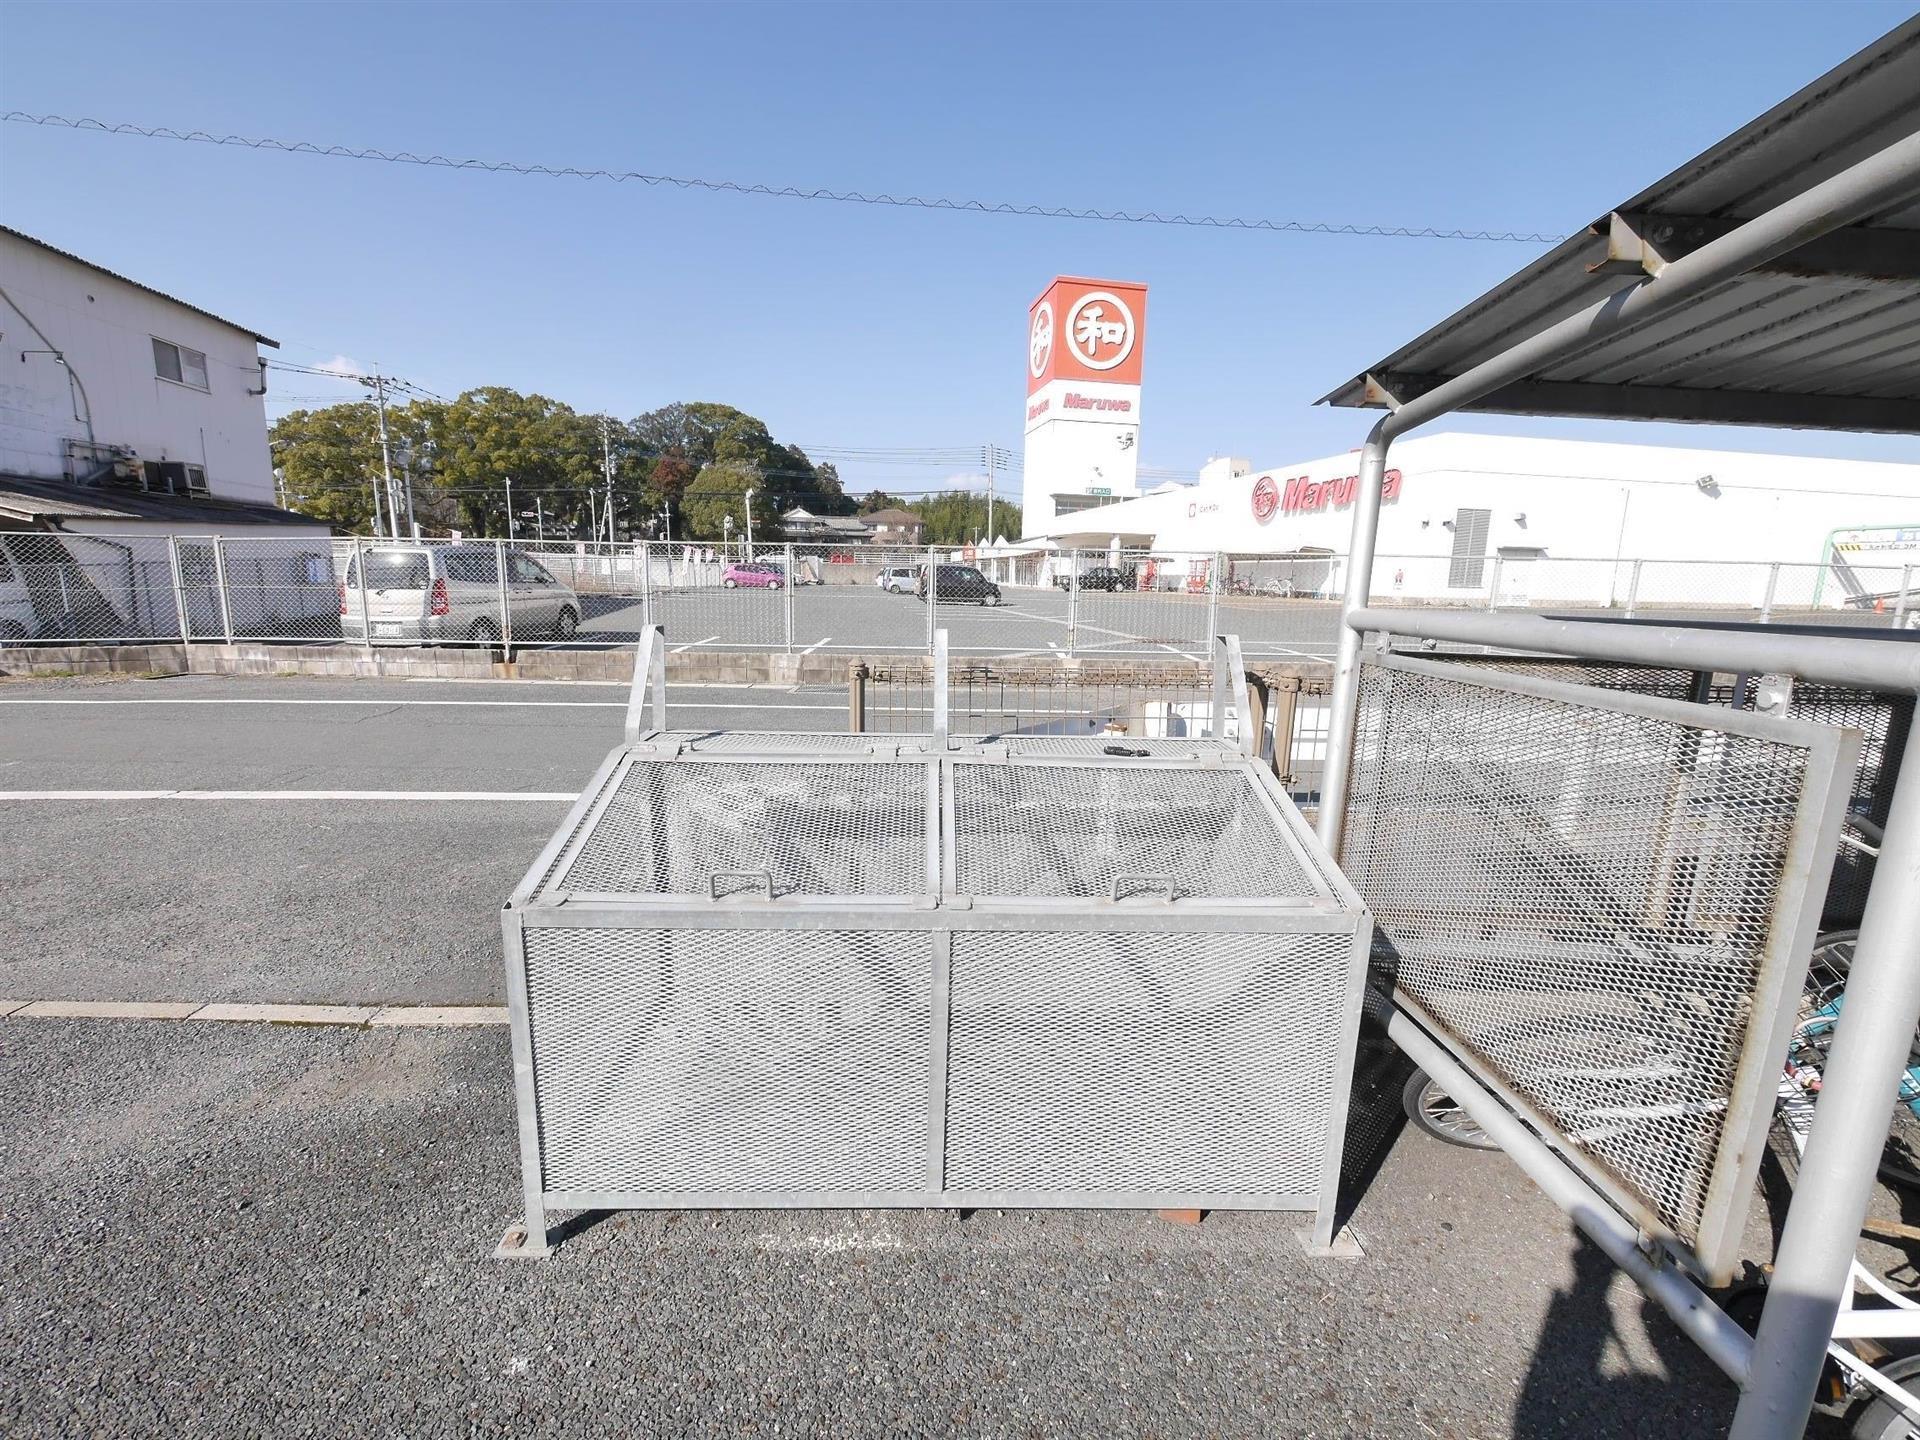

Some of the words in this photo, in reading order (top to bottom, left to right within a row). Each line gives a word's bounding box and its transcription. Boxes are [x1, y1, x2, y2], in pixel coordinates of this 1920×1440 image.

[1076, 306, 1127, 356] 和
[1064, 393, 1131, 412] Maruwa
[1282, 469, 1401, 511] Marua
